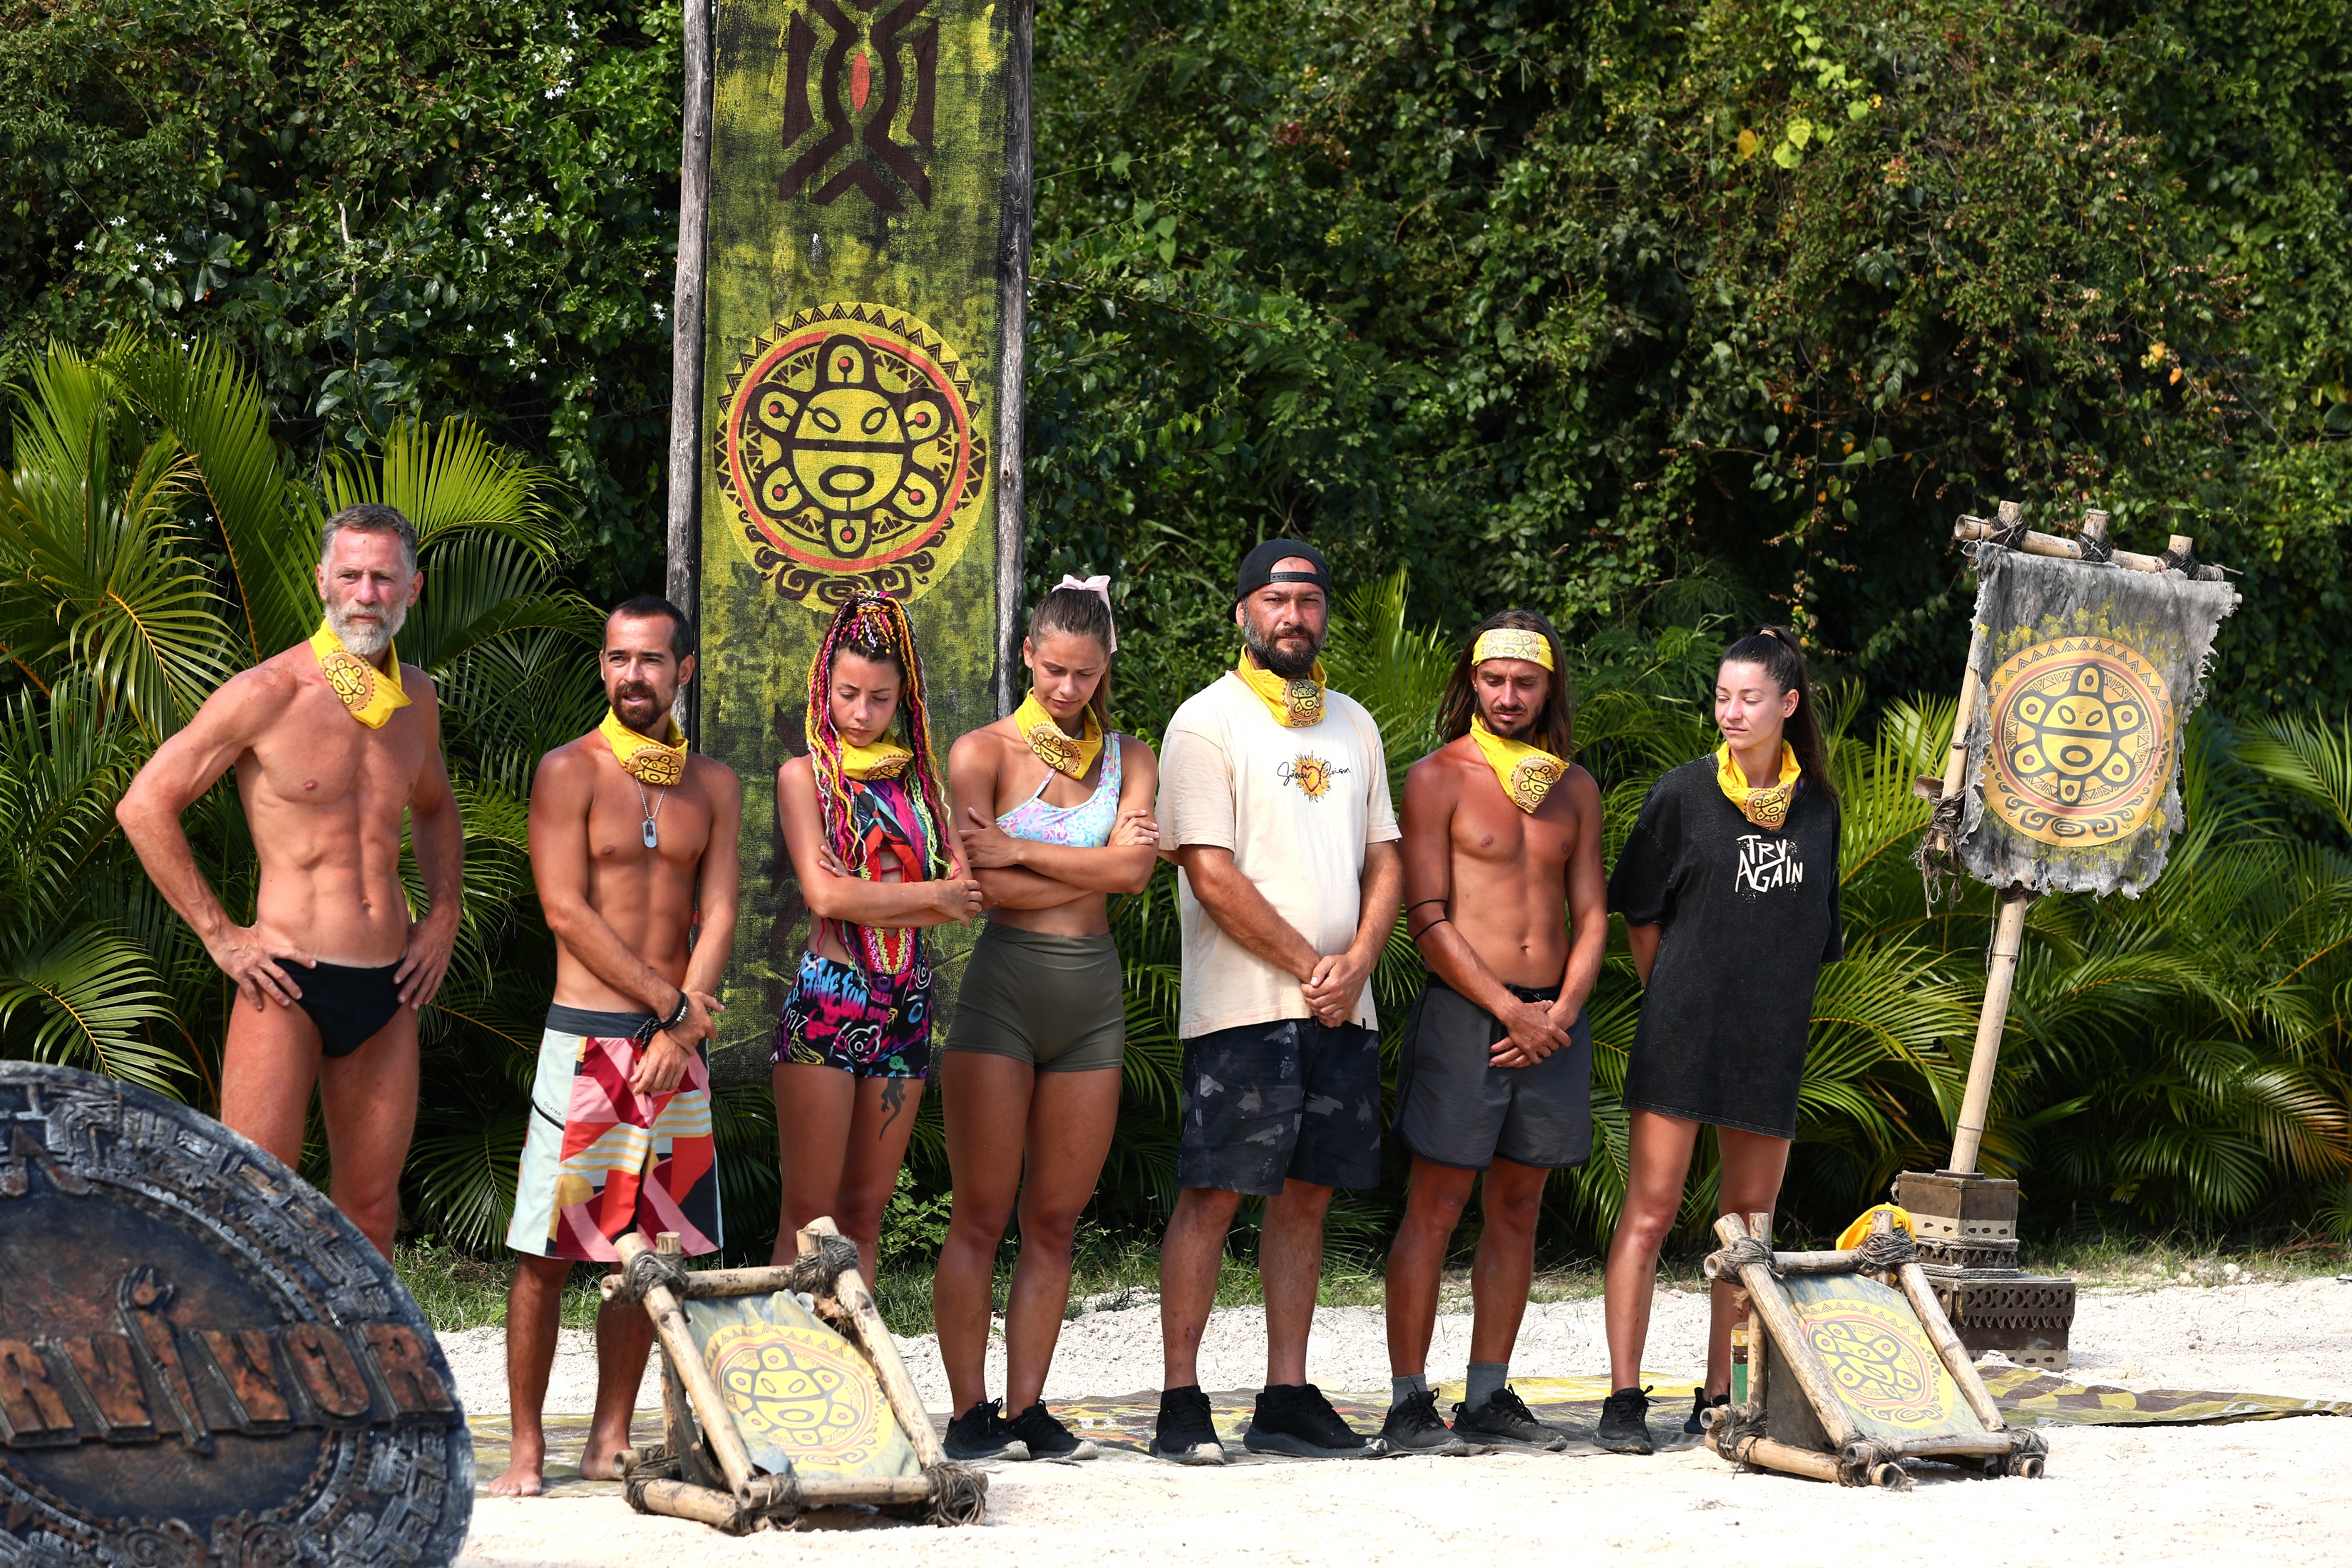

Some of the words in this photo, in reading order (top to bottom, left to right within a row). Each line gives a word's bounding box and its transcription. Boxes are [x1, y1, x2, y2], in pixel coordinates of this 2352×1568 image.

[1736, 834, 1787, 865] TRY
[1735, 849, 1804, 893] AGAIN
[543, 1101, 562, 1117] OLAIAN
